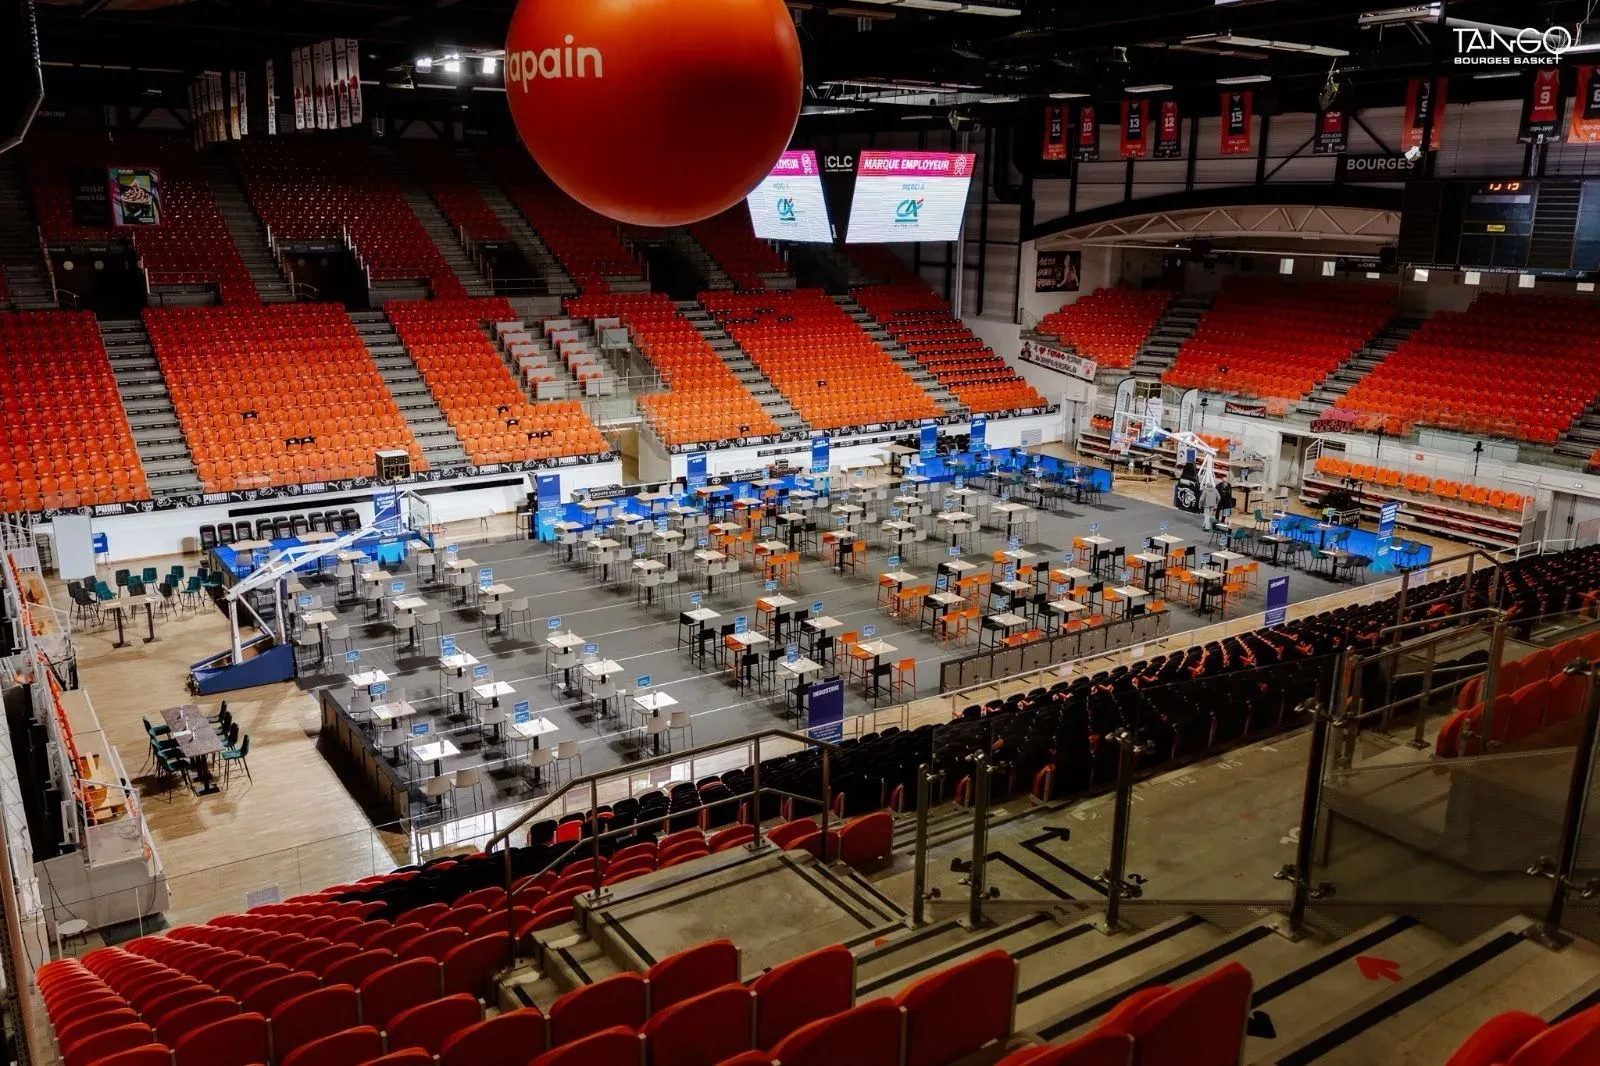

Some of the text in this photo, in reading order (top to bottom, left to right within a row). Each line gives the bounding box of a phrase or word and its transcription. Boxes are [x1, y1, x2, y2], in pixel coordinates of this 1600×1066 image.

[827, 155, 853, 169] CLC
[864, 158, 949, 171] MARQUE EMPLOYEUR
[1347, 158, 1415, 170] BOURGES
[813, 685, 840, 698] INDUSTRIE
